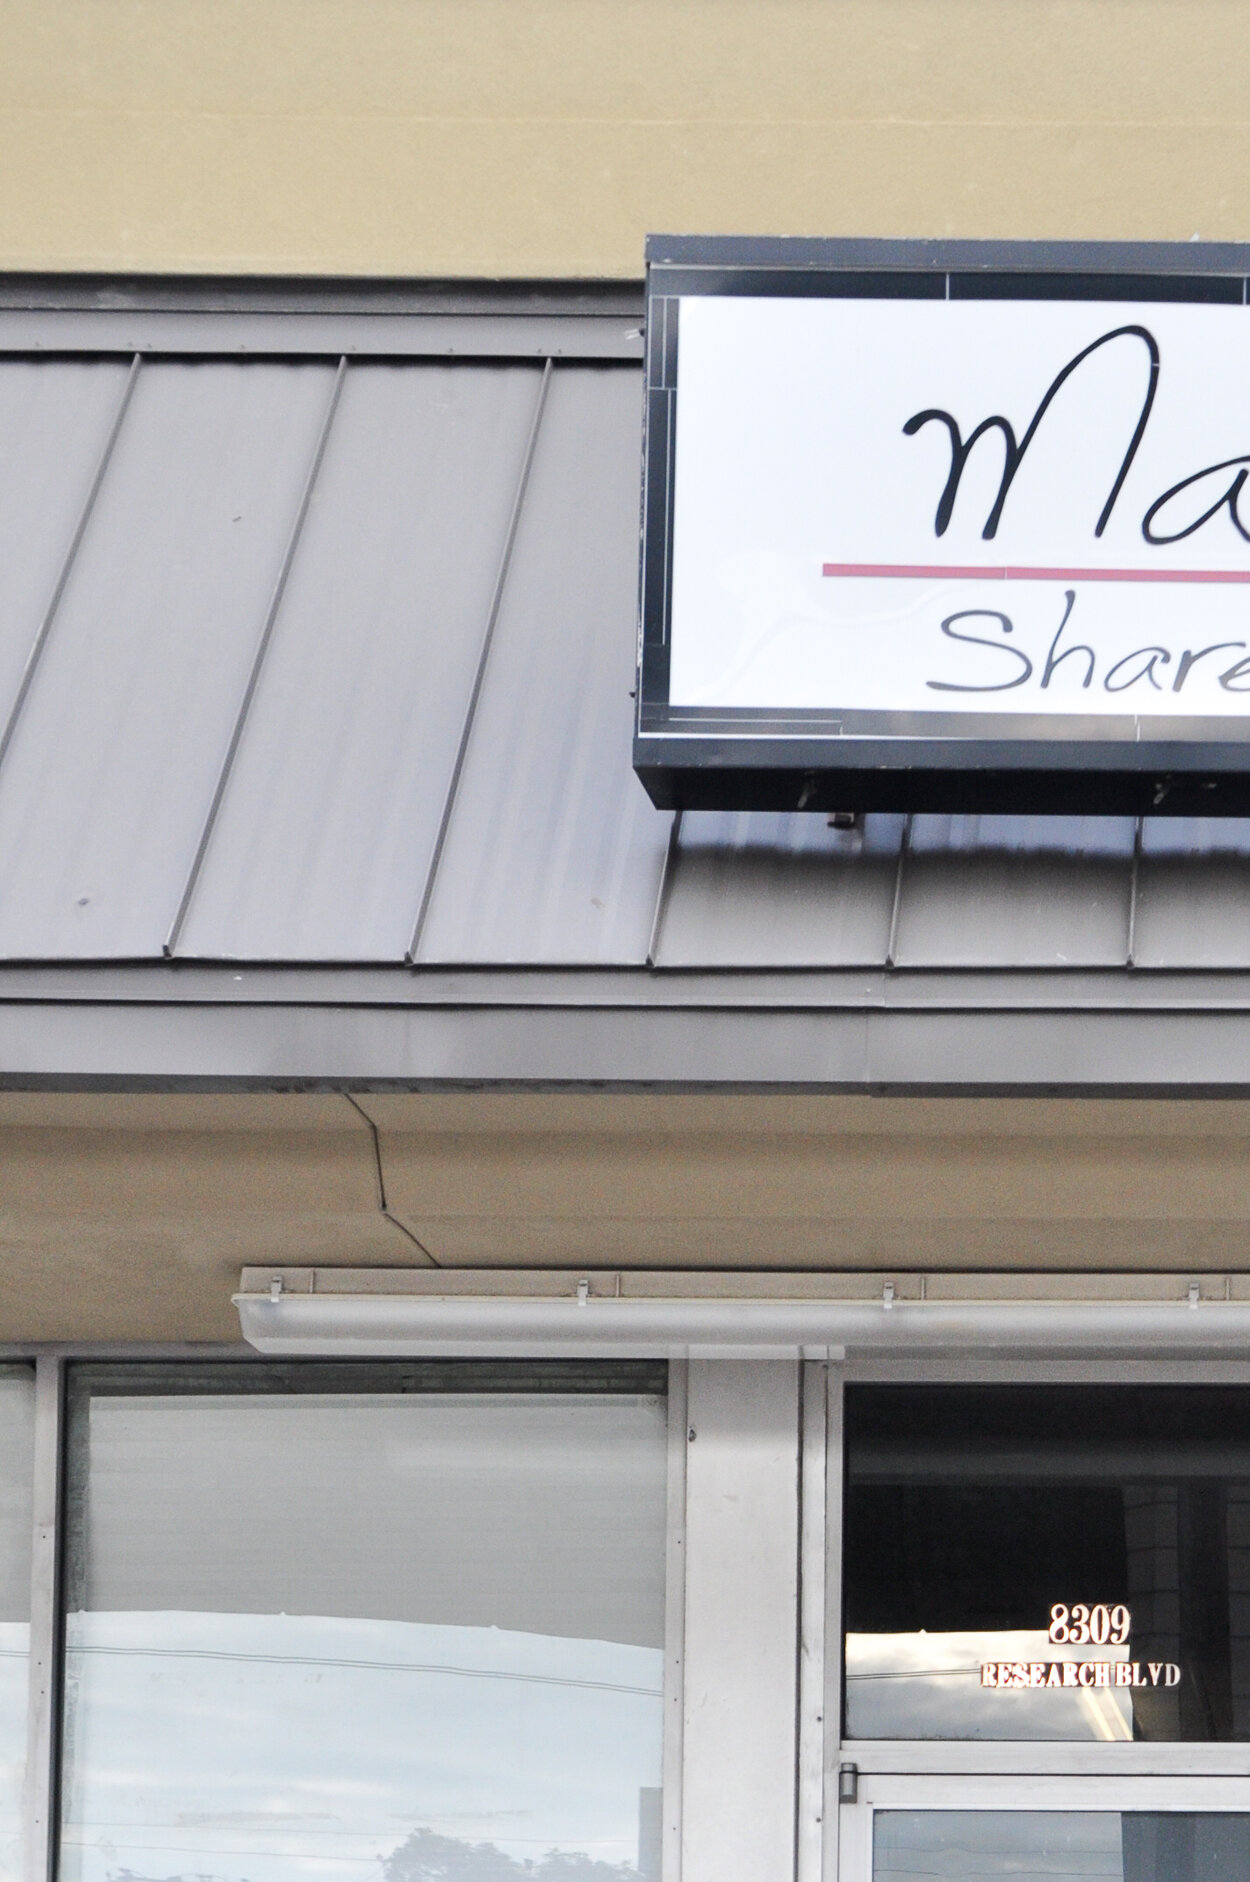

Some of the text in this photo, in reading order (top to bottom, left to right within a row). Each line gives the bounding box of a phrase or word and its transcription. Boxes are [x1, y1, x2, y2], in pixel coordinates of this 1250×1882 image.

[1049, 1603, 1131, 1644] 8309
[982, 1662, 1181, 1687] RESEARCH BLVD
